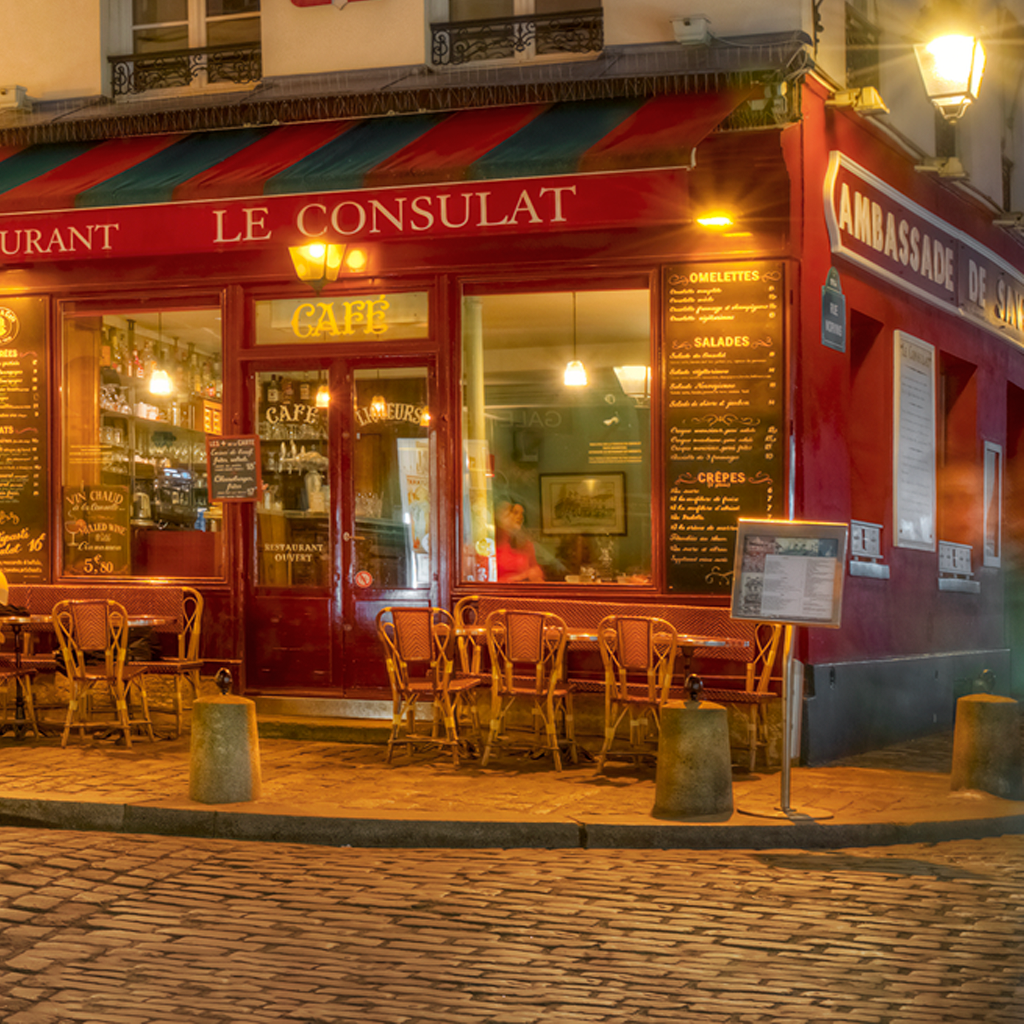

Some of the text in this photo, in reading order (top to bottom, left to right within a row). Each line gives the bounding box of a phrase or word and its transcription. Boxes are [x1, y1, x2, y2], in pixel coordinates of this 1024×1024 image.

[213, 207, 272, 243] LE
[296, 185, 577, 238] CONSULAT
[839, 182, 954, 292] AMBASSADE
[968, 258, 986, 309] DE
[689, 271, 760, 283] OMELETTES
[291, 294, 390, 338] CAFÉ
[694, 336, 750, 348] SALADES
[697, 471, 746, 483] CRÊPES
[65, 490, 124, 505] VIN CHAUD
[264, 543, 323, 552] RESTAURANT
[274, 552, 312, 563] OUVERT
